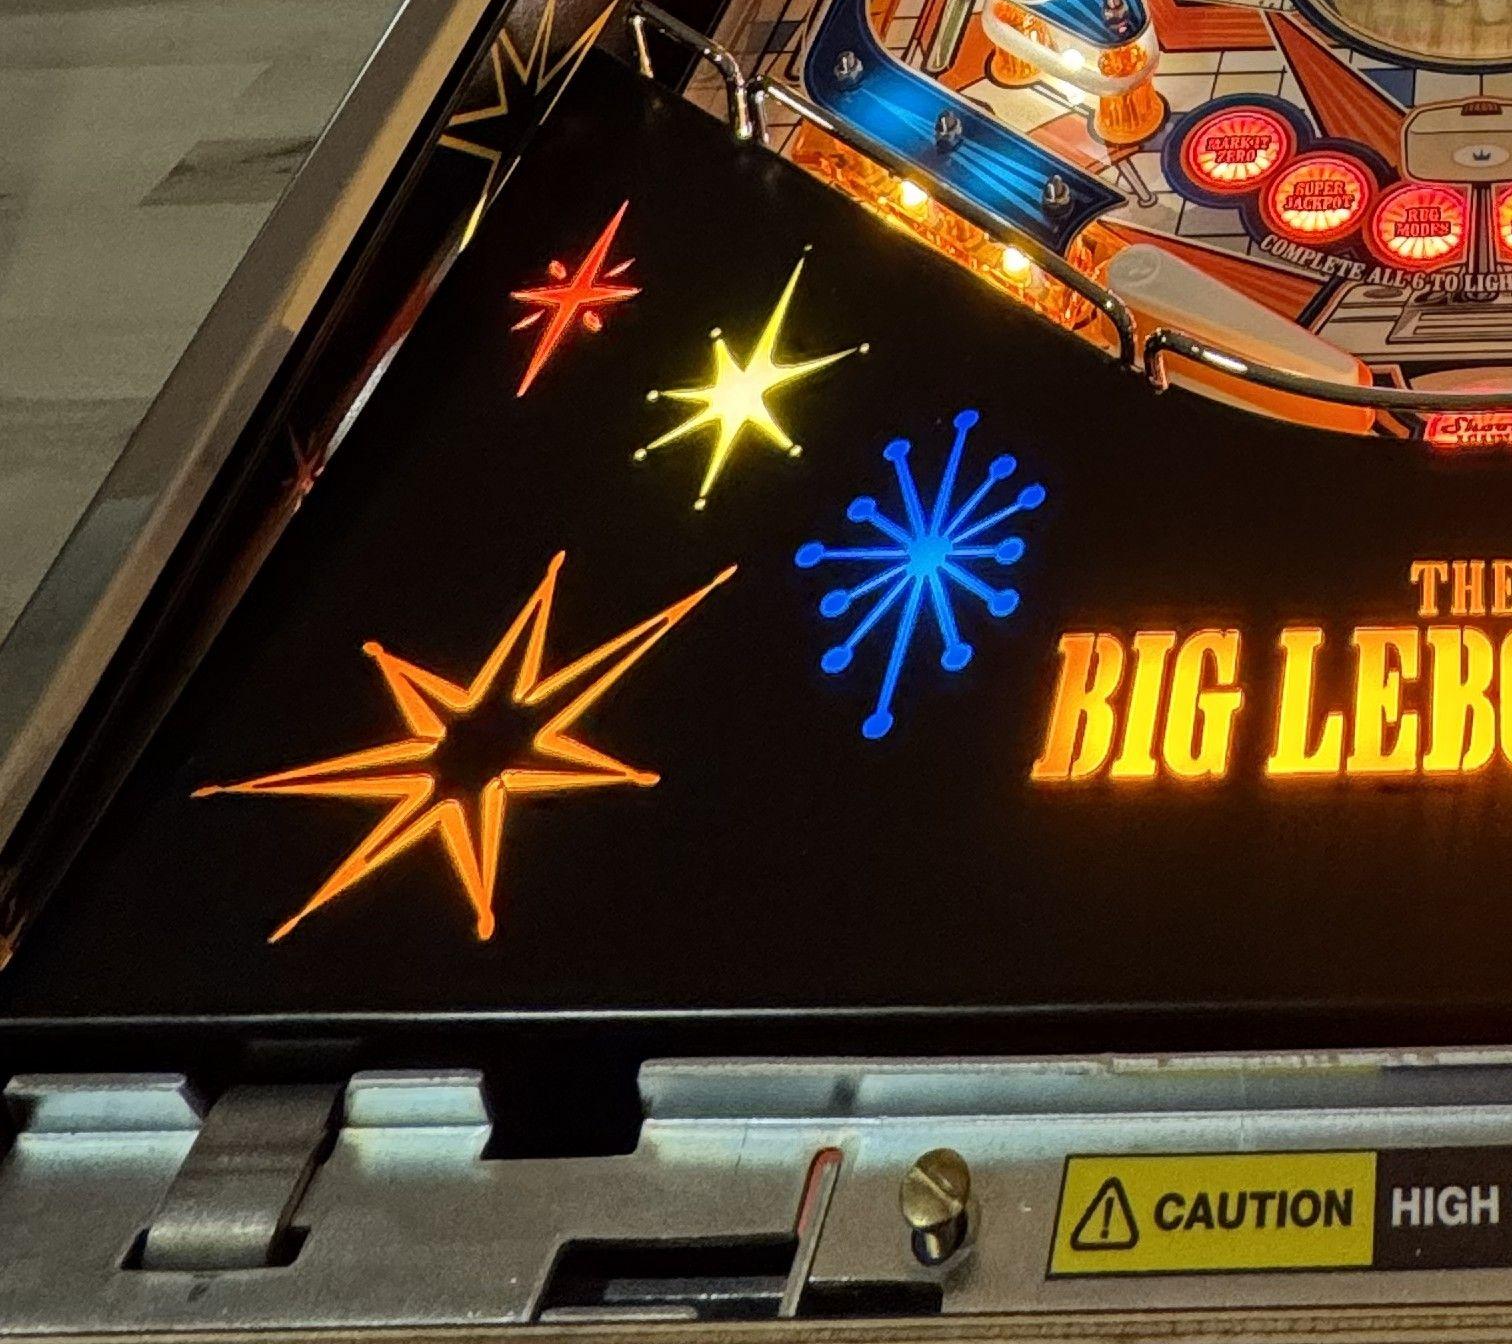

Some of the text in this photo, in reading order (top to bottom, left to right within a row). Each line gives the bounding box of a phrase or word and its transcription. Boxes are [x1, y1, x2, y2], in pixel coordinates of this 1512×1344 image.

[1206, 136, 1271, 151] MARK IT
[1216, 150, 1257, 162] ZERO
[1295, 182, 1346, 195] SUPER
[1285, 195, 1354, 210] JACKPOT
[1407, 208, 1441, 222] RUG
[1395, 222, 1451, 237] MODES
[1259, 233, 1367, 281] COMPLETE
[1367, 263, 1405, 288] ALL
[1411, 271, 1425, 289] 6
[1428, 272, 1459, 293] TO
[1031, 627, 1245, 780] BIG
[1154, 1188, 1354, 1231] CAUTION
[1391, 1184, 1499, 1227] HIGH
